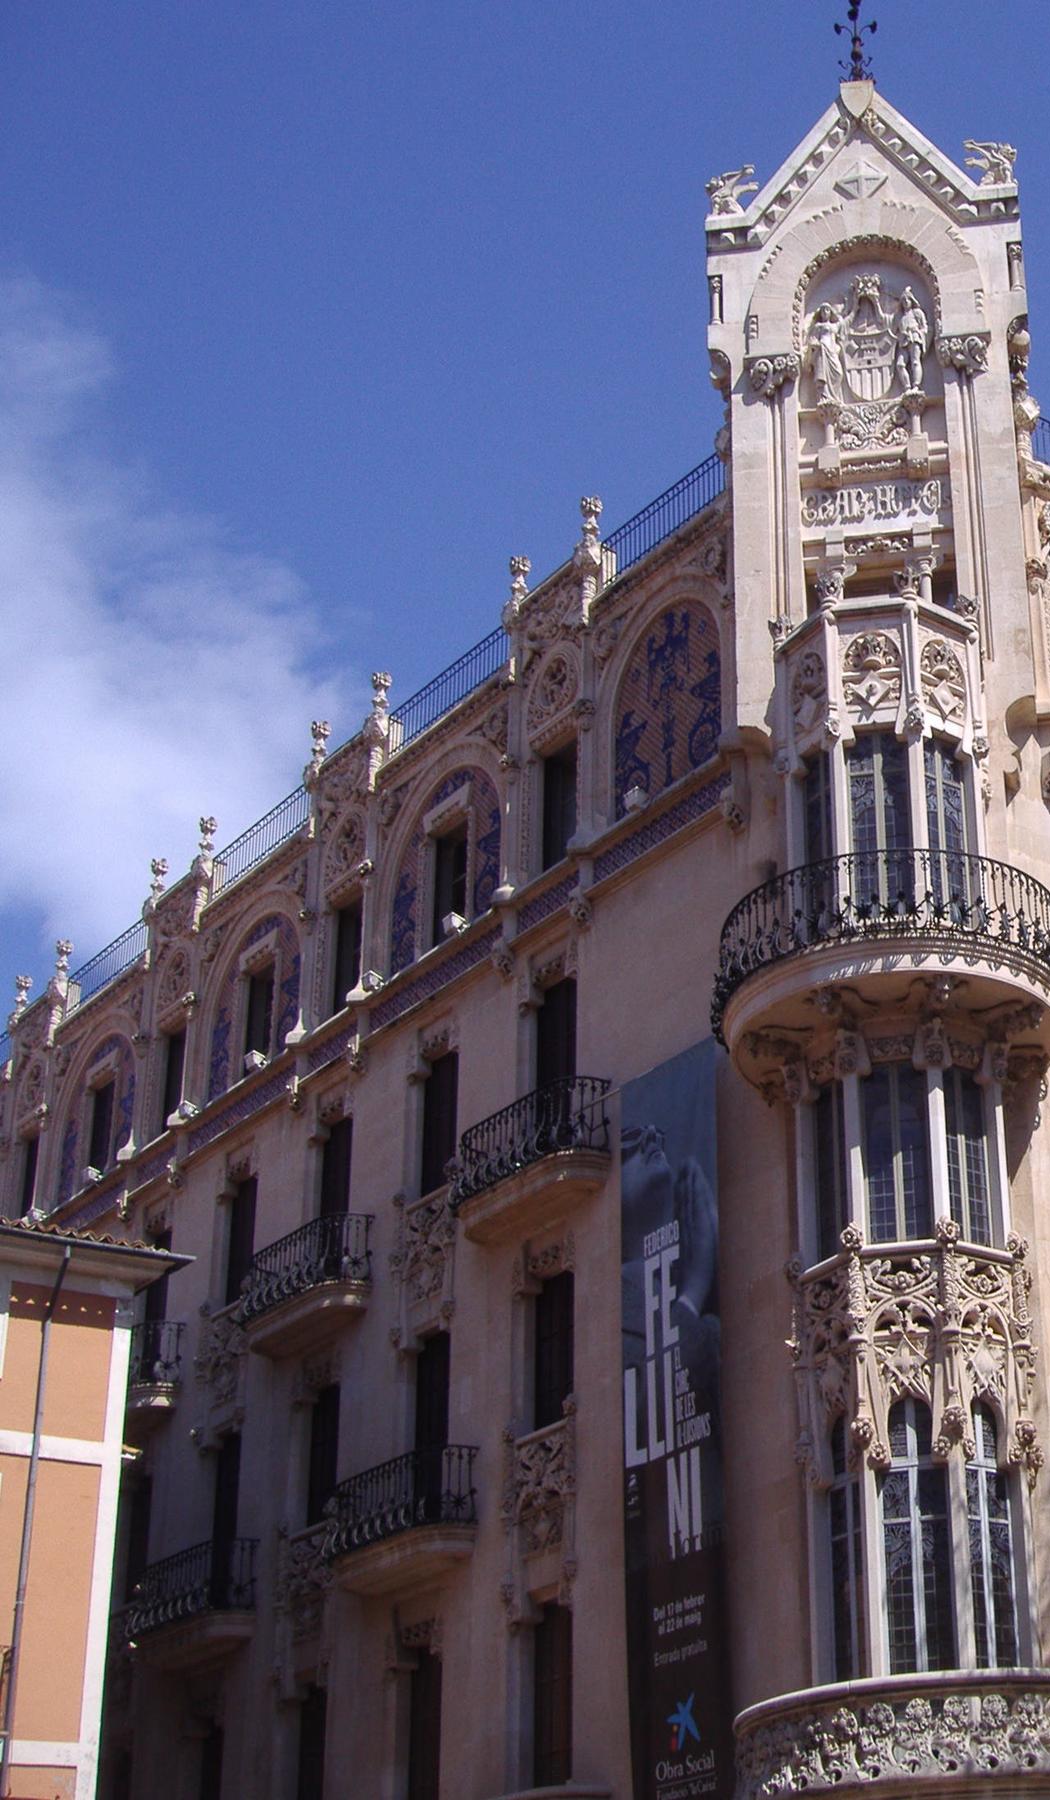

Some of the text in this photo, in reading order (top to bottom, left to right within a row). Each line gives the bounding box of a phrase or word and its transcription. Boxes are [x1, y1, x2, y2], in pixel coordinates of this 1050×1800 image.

[643, 1219, 680, 1258] FEDERICO
[644, 1243, 680, 1358] FE
[666, 1445, 703, 1561] NI
[666, 1617, 675, 1633] 22
[655, 1749, 715, 1781] Obra Social
